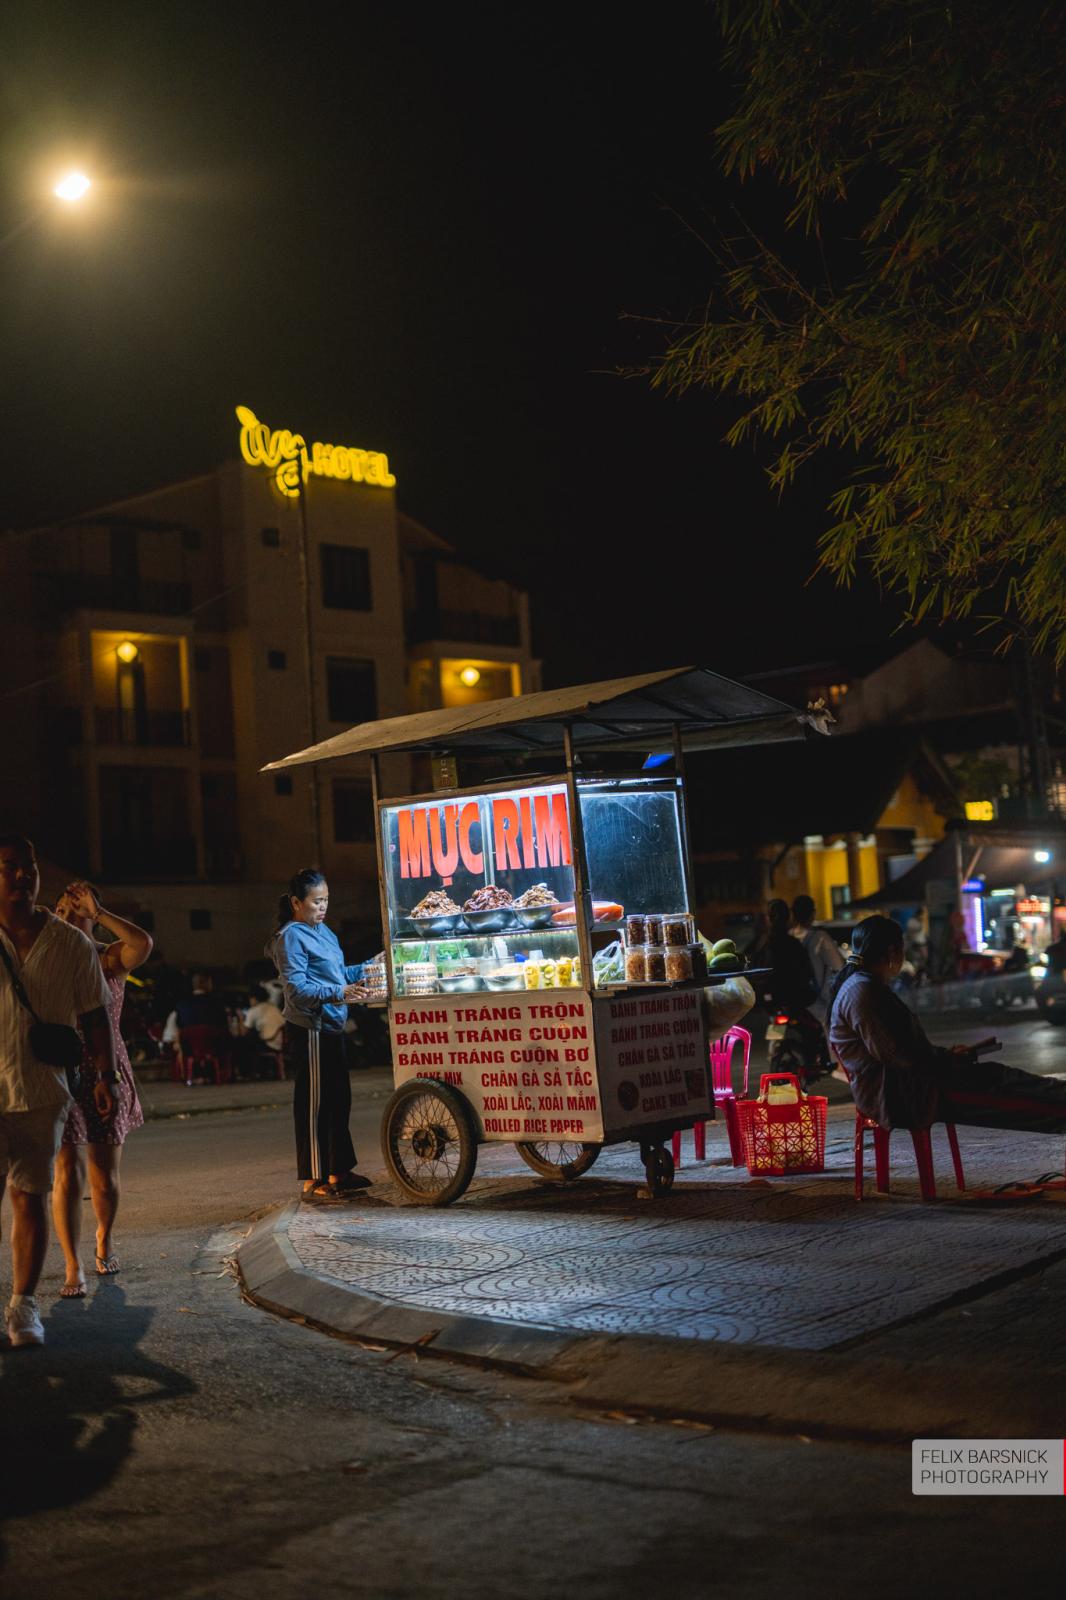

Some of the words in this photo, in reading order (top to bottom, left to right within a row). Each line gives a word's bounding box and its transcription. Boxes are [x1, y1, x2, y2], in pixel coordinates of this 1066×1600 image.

[312, 442, 397, 487] HOTEL
[398, 802, 485, 887] MỰC
[493, 793, 572, 871] RIM
[395, 1009, 447, 1025] BÁNH
[454, 1005, 521, 1022] TRÁNG
[528, 1002, 584, 1021] TRỘN
[397, 1030, 449, 1045] BÁNH
[455, 1027, 522, 1043] TRÁNG
[529, 1023, 587, 1042] CUỘN
[399, 1051, 443, 1065] BÁNH
[448, 1047, 504, 1064] TRÁNG
[511, 1047, 558, 1064] CUỘN
[565, 1047, 590, 1061] BƠ
[481, 1070, 517, 1087] CHÂN
[522, 1069, 539, 1086] GÀ
[566, 1066, 592, 1086] TẮC
[483, 1093, 508, 1111] XOÀI
[538, 1093, 563, 1111] XOÀI
[567, 1091, 596, 1111] MẮM
[485, 1118, 520, 1132] ROLLED
[524, 1119, 547, 1132] RICE
[551, 1119, 583, 1133] PAPER
